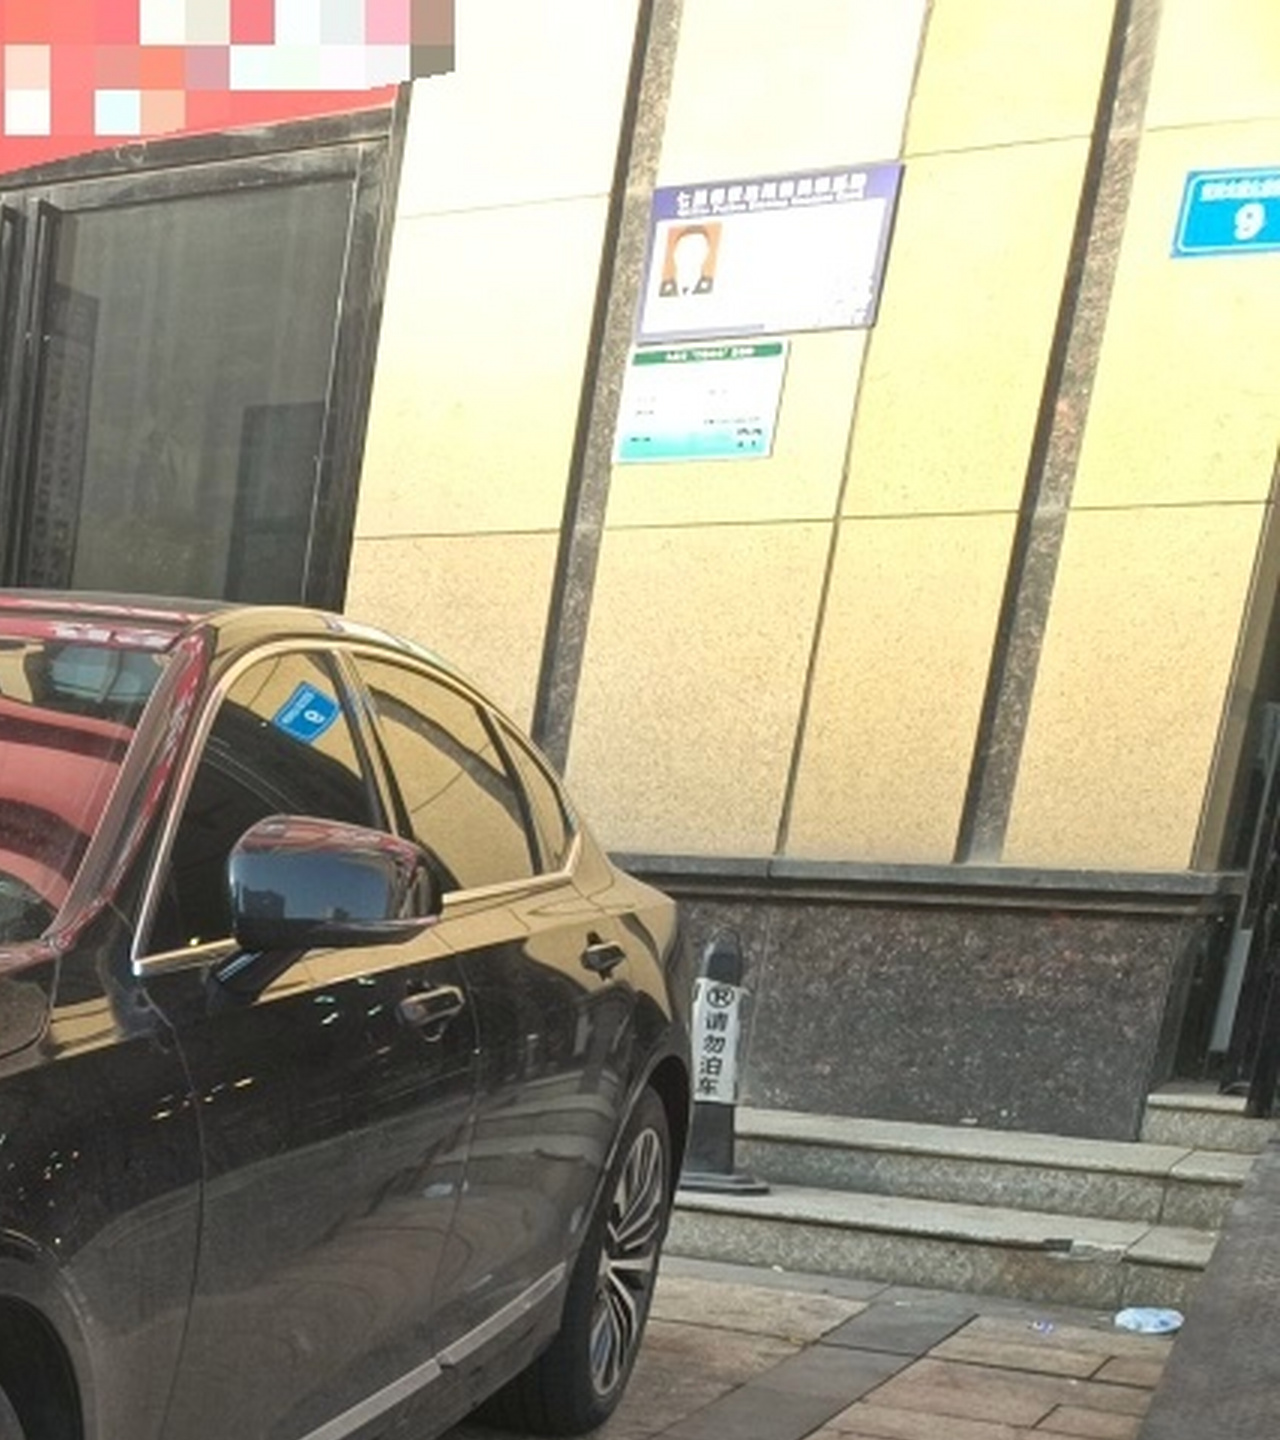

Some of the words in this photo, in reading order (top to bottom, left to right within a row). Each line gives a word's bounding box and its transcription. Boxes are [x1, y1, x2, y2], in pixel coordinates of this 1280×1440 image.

[1233, 202, 1267, 241] 9
[699, 1011, 729, 1095] 请勿泊车
